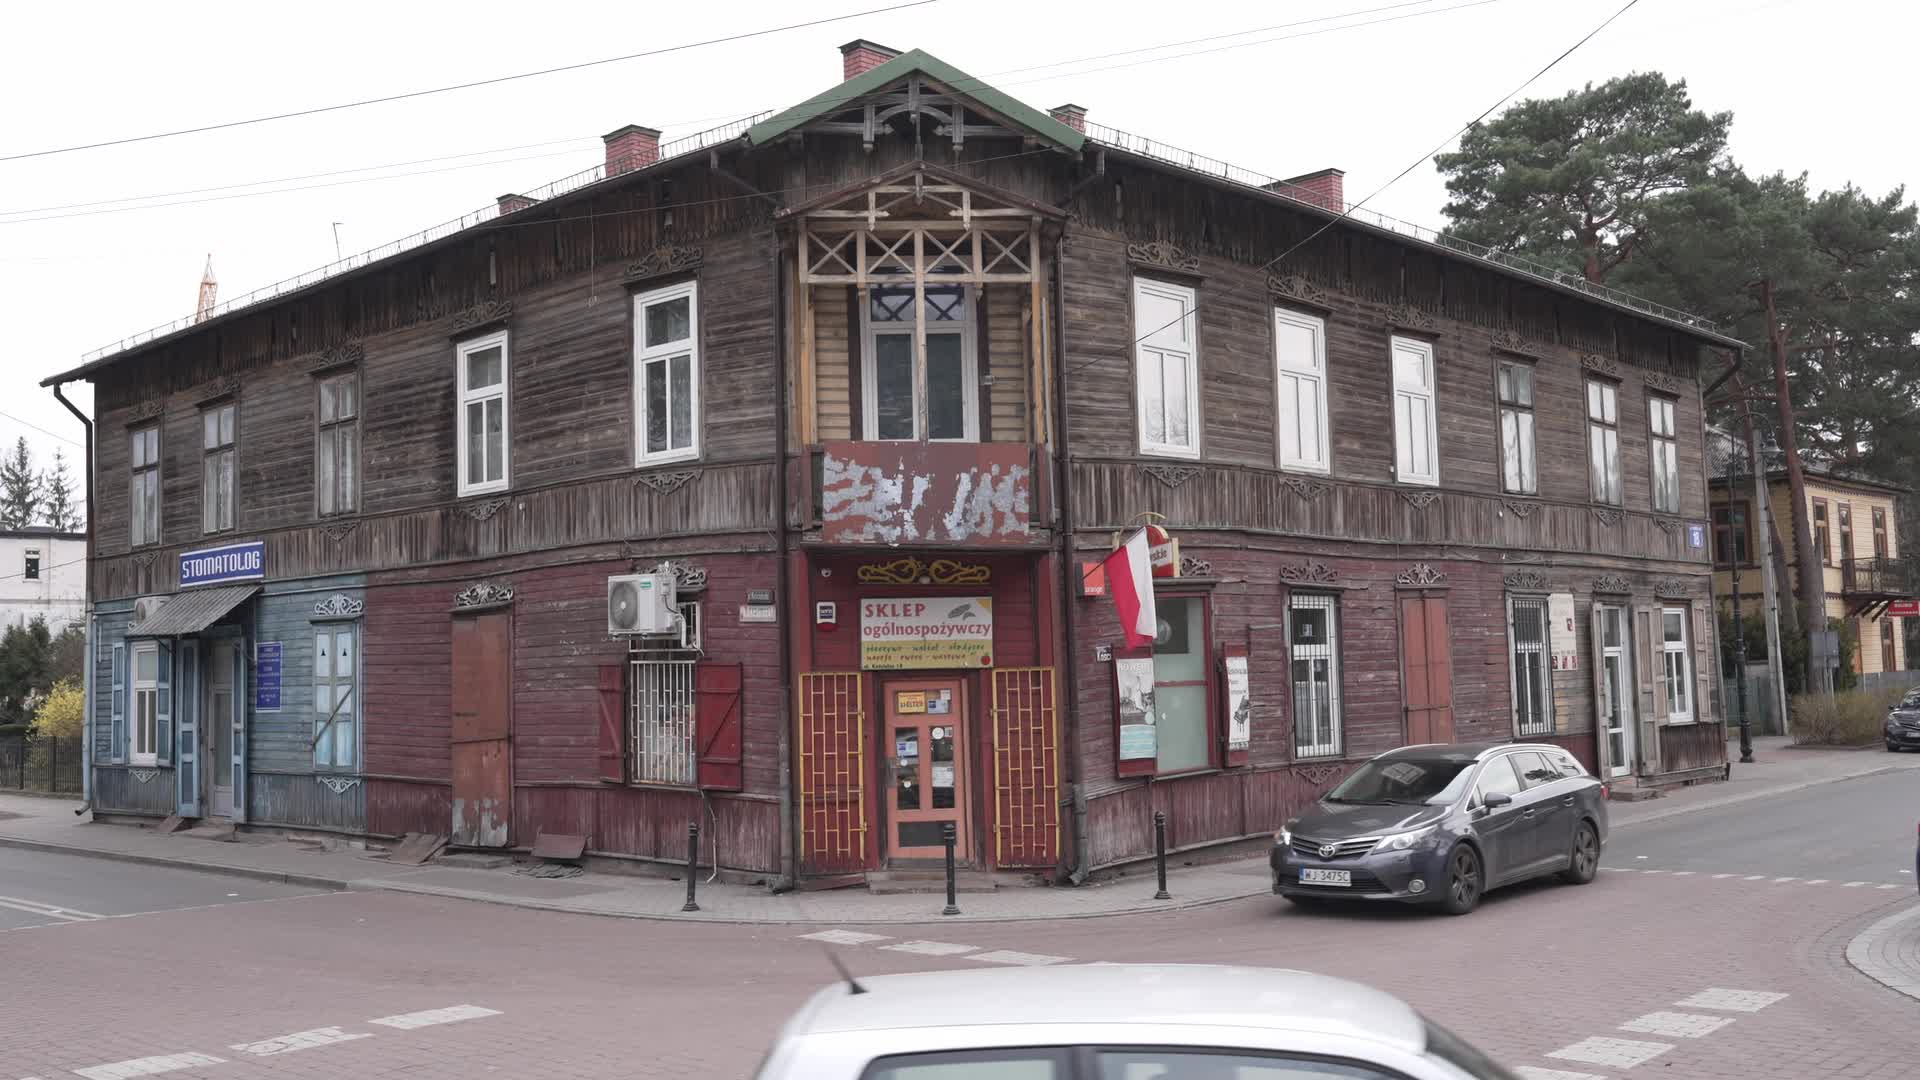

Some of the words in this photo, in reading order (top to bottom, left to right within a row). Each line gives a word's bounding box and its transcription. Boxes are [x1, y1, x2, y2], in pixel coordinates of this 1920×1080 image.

[182, 551, 260, 579] STOMATOLOG
[865, 603, 925, 618] SKLEP
[863, 621, 992, 638] ogólnospożywczy
